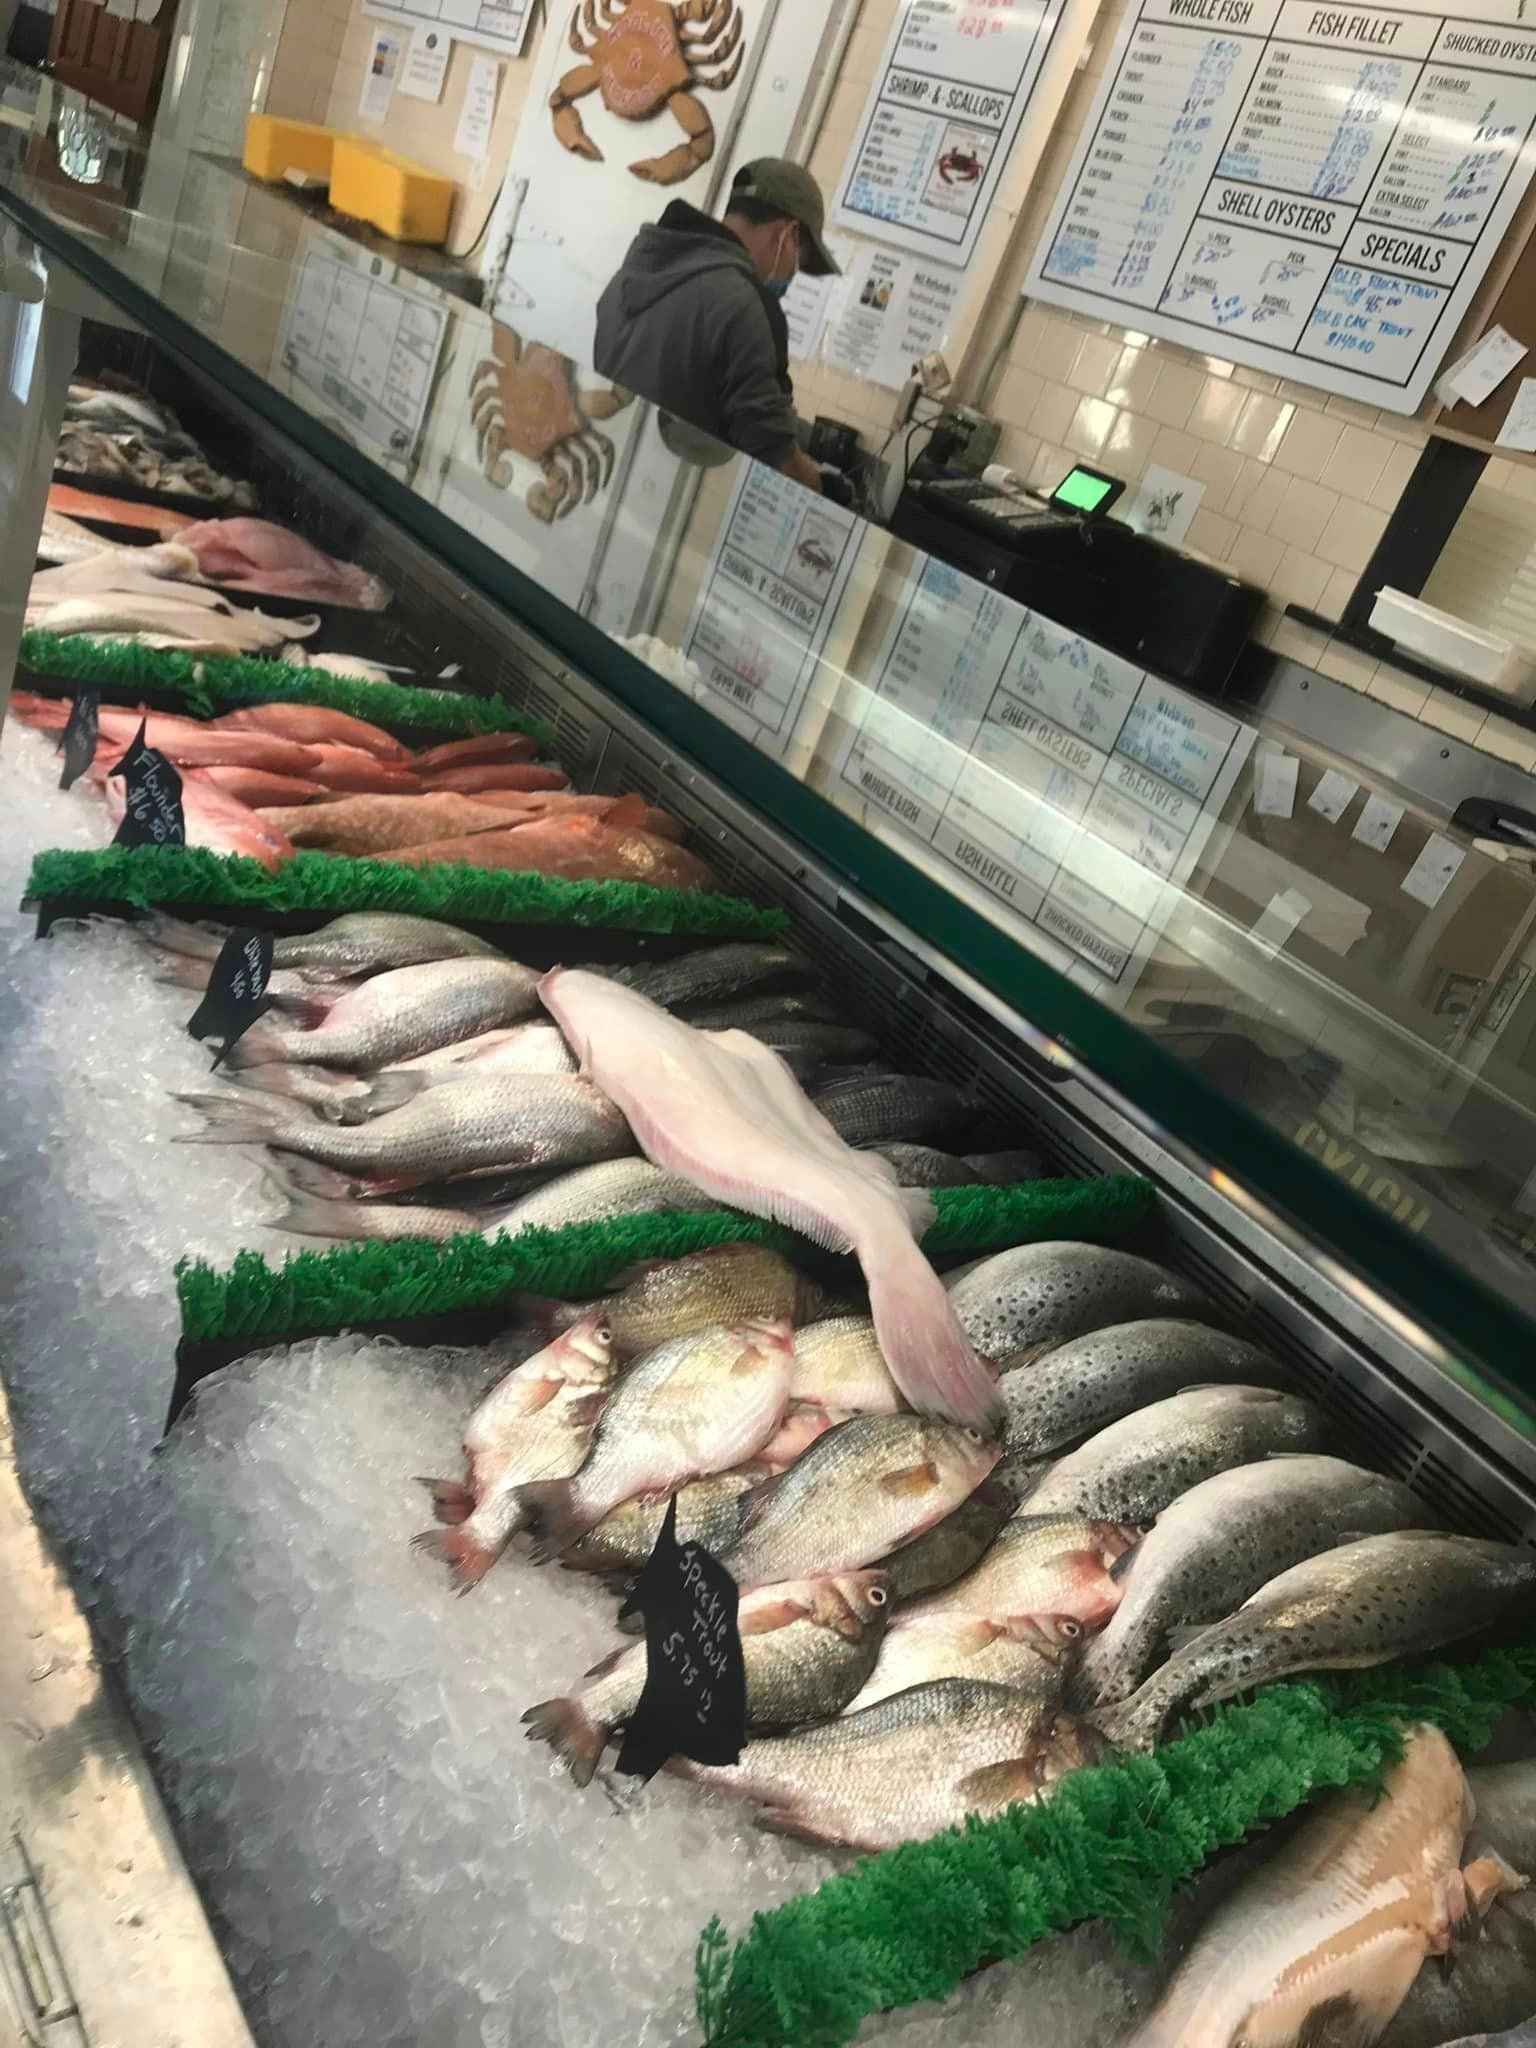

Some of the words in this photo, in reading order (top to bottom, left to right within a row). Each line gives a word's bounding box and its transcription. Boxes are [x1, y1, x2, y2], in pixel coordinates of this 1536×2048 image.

[1169, 0, 1217, 20] WHOLE
[1216, 1, 1254, 24] FISH
[1307, 12, 1352, 38] FISH
[1350, 17, 1403, 45] FILLET
[1443, 31, 1501, 56] SHUCKED
[1272, 51, 1291, 64] TUNA
[1265, 66, 1284, 79] ROCK
[1259, 80, 1278, 93] MAHI
[1427, 74, 1472, 94] STANDARD
[888, 75, 929, 99] SHRIMP
[931, 86, 942, 104] &
[946, 89, 1004, 120] SCALLOPS
[1252, 96, 1282, 111] SALMON
[1247, 110, 1282, 127] FLOUNDER
[1241, 126, 1263, 140] TROUT
[1401, 132, 1431, 148] SELECT
[1234, 141, 1250, 153] COD
[1388, 163, 1409, 174] QUART
[1383, 175, 1406, 187] GALLON
[1375, 189, 1401, 206] EXTRA
[1399, 193, 1430, 211] SELECT
[1218, 189, 1263, 219] SHELL
[1264, 199, 1336, 236] OYSTERS
[1369, 206, 1391, 218] GALLON
[1214, 234, 1232, 246] PECK
[1287, 251, 1306, 264] PECK
[1361, 233, 1447, 273] SPECIALS
[133, 748, 183, 840] Flounder
[679, 1550, 729, 1643] Speckle
[692, 1608, 728, 1680] Trout
